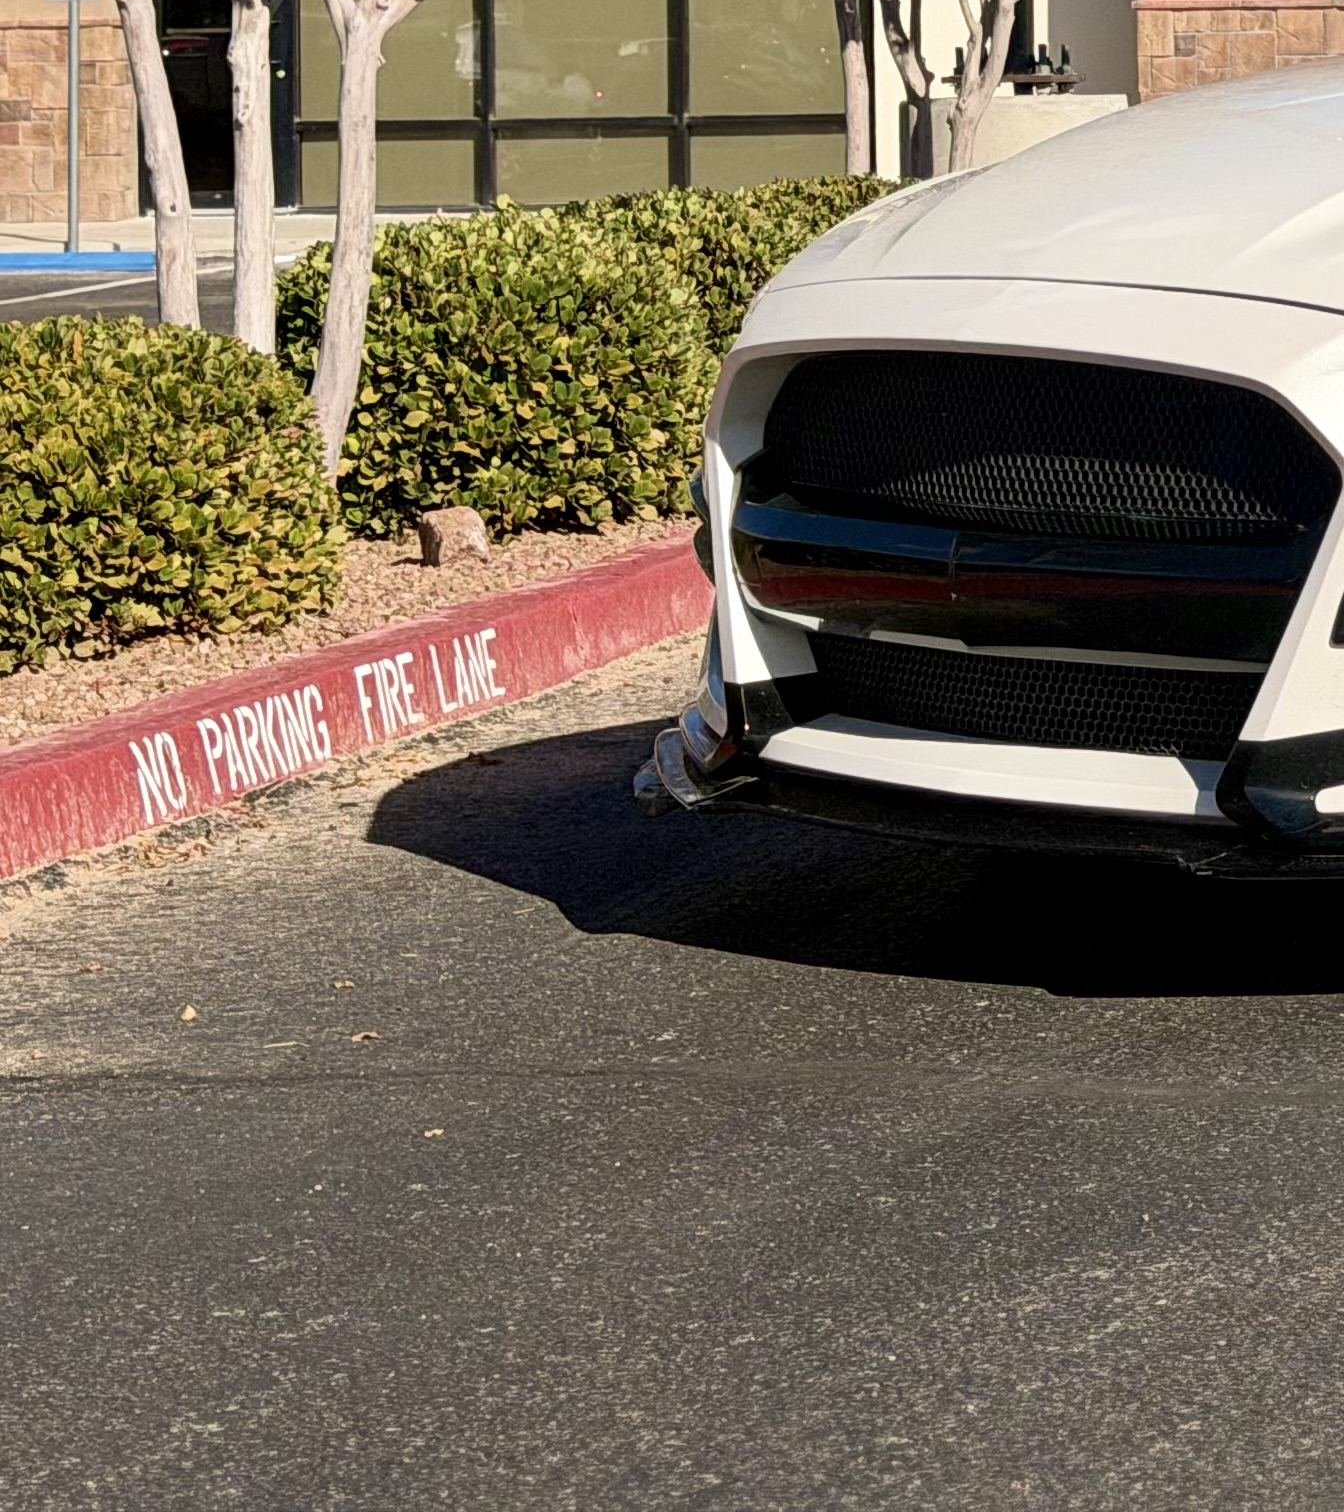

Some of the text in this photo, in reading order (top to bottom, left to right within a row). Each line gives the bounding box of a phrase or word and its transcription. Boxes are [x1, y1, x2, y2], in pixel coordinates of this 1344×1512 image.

[129, 628, 507, 826] NO PARKING FIRE LANE
